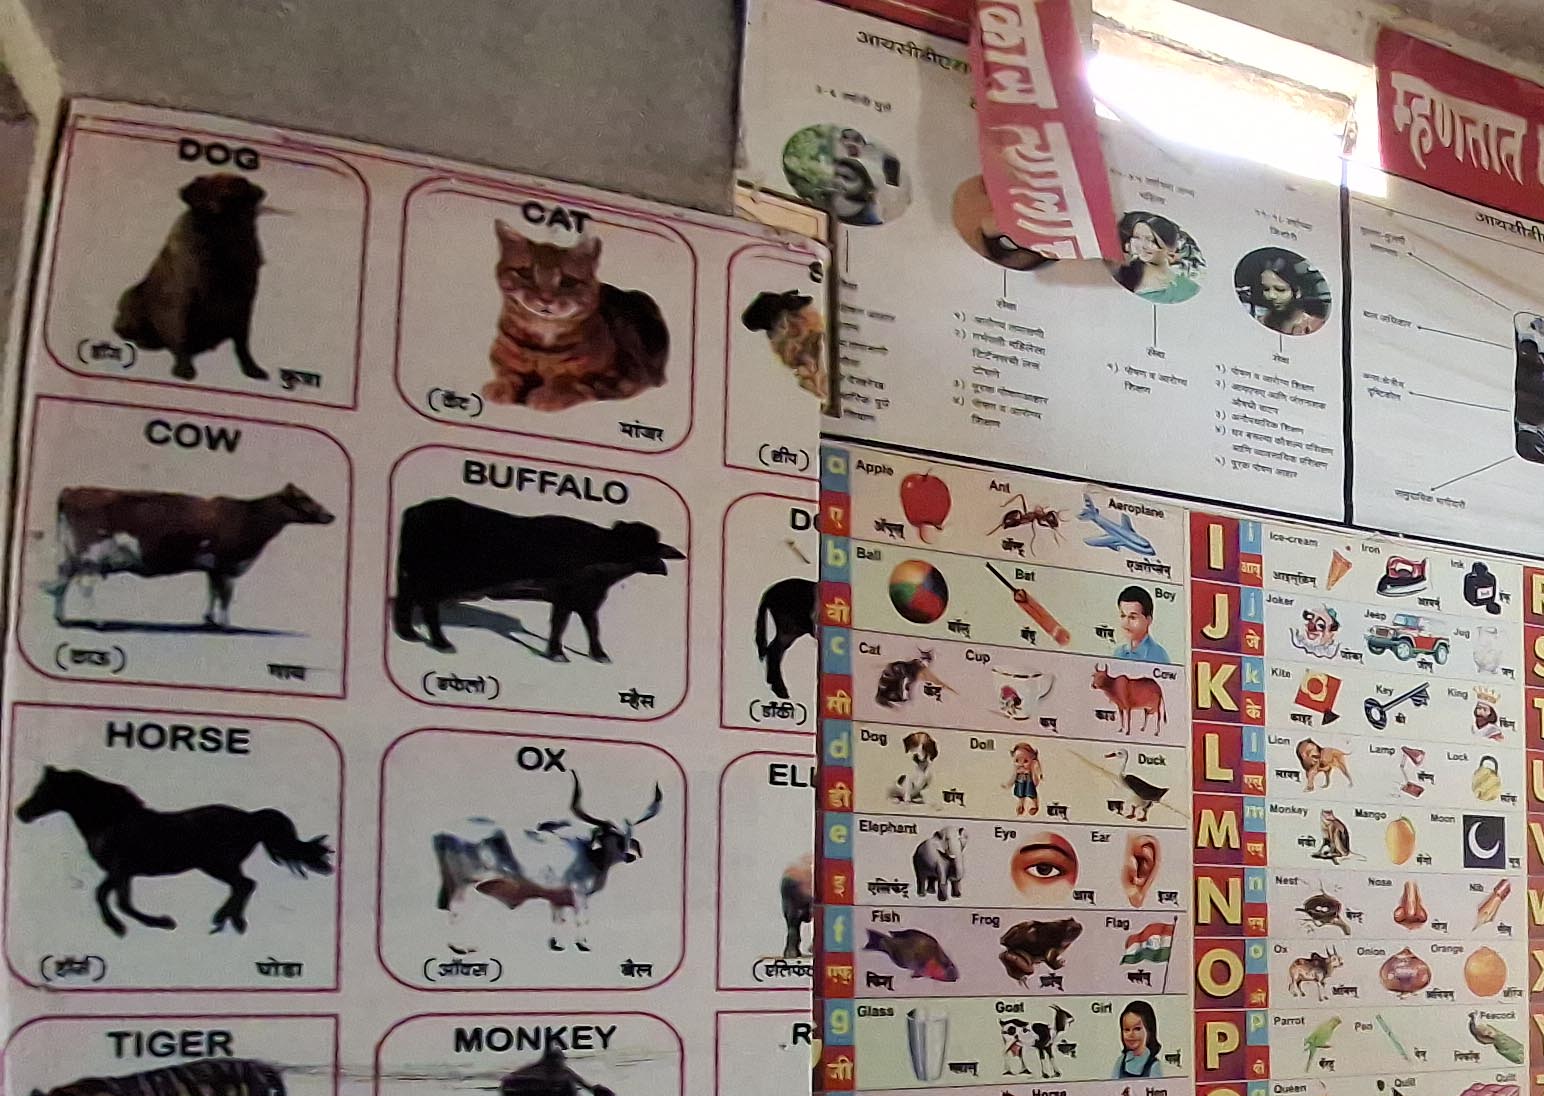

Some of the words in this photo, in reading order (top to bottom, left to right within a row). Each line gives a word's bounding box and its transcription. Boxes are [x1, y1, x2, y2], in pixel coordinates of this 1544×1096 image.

[1391, 71, 1526, 187] म्हणतात
[178, 137, 260, 172] DOG
[520, 202, 591, 234] CAT
[144, 420, 242, 454] COW
[855, 460, 894, 477] Apple
[463, 460, 630, 506] BUFFALO
[989, 479, 1010, 493] Ant
[1108, 498, 1164, 519] Aeroplane
[1269, 532, 1318, 547] Ice-cream
[857, 547, 881, 561] Ball
[1361, 543, 1380, 554] Iron
[1015, 569, 1035, 582] Bat
[1155, 587, 1176, 603] Boy
[1266, 595, 1293, 606] Joker
[1202, 594, 1228, 640] J
[1364, 611, 1387, 622] Jeep
[859, 642, 880, 656] Cat
[965, 650, 991, 665] Cup
[1152, 668, 1177, 680] Cow
[1271, 668, 1292, 678] Kite
[1197, 661, 1239, 712] K
[1447, 688, 1468, 699] King
[106, 721, 252, 756] HORSE
[860, 730, 887, 748] Dog
[970, 737, 995, 750] Doll
[1268, 735, 1290, 746] Lion
[1205, 733, 1234, 781] L
[1369, 745, 1395, 757] Lamp
[517, 746, 568, 773] OX
[1137, 753, 1166, 767] Duck
[1269, 804, 1308, 817] Monkey
[1355, 809, 1387, 821] Mango
[1430, 813, 1455, 824] Moon
[859, 820, 917, 835] Elephant
[994, 828, 1016, 841] Eye
[1197, 810, 1240, 849] M
[1368, 877, 1392, 887] Nose
[1198, 878, 1241, 924] N
[871, 910, 900, 924] Fish
[972, 914, 1000, 928] Frog
[1105, 917, 1130, 931] Flag
[1357, 947, 1386, 956] Onion
[1430, 943, 1464, 955] Orange
[1198, 948, 1243, 996] O
[857, 1005, 895, 1018] Glass
[995, 1001, 1024, 1014] Goat
[1091, 1002, 1112, 1014] Girl
[1273, 1016, 1305, 1027] Parrot
[107, 1030, 235, 1060] TIGER
[454, 1025, 618, 1053] MONKEY
[1206, 1021, 1239, 1069] P
